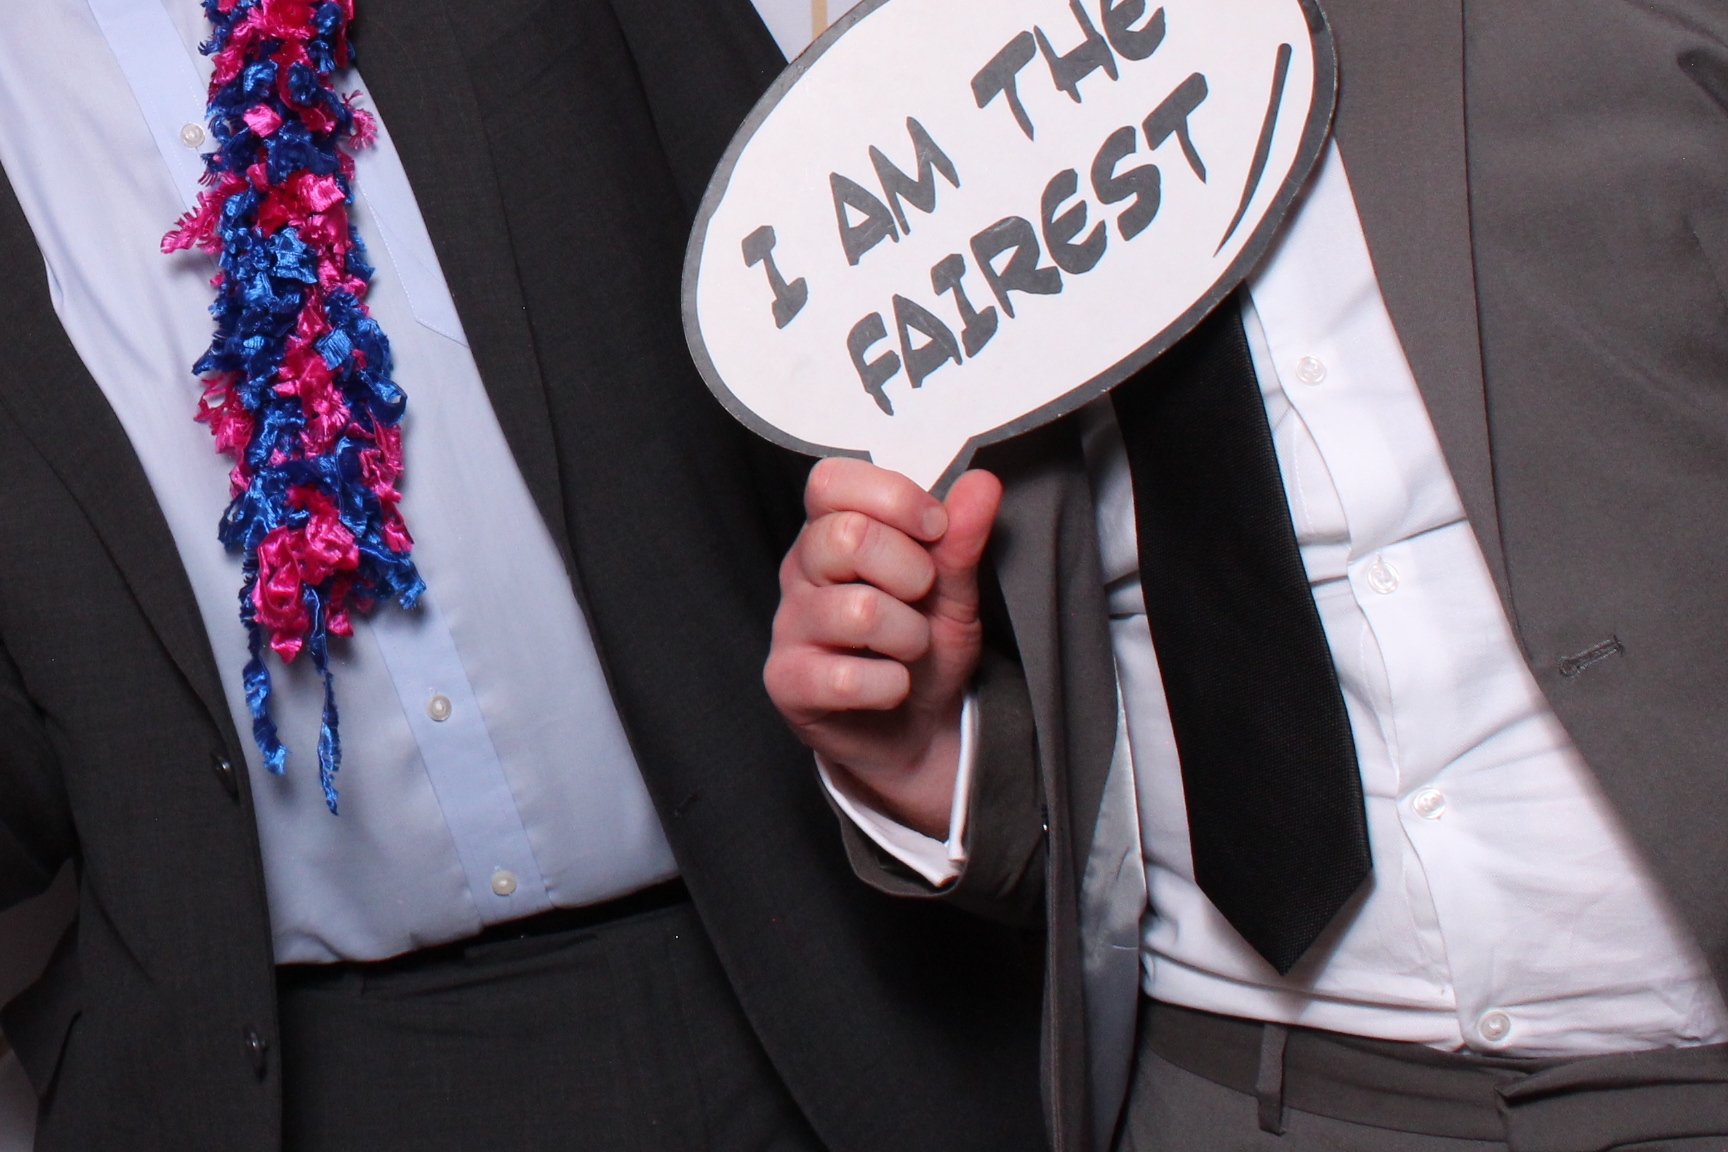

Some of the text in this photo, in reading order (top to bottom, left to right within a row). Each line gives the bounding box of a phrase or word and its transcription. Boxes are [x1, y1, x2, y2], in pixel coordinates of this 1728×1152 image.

[741, 224, 808, 329] I
[829, 115, 961, 266] AM
[846, 71, 1209, 416] FAIREST
